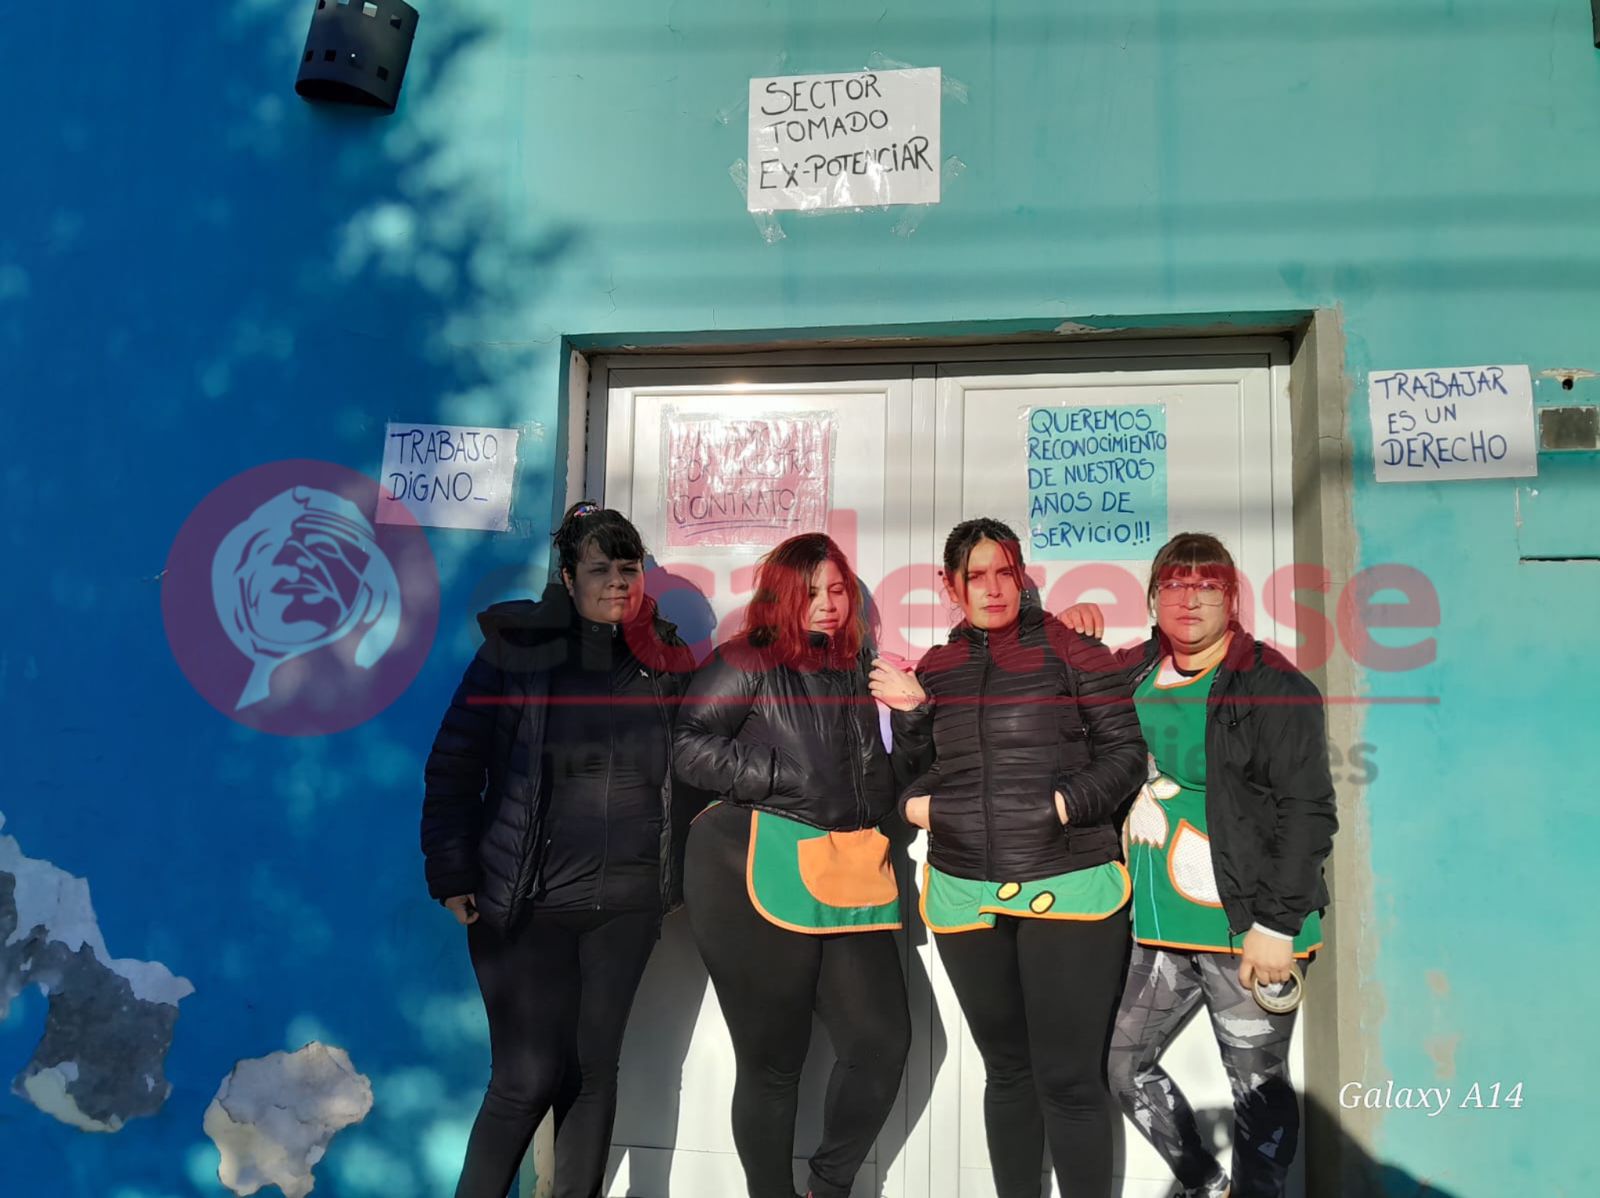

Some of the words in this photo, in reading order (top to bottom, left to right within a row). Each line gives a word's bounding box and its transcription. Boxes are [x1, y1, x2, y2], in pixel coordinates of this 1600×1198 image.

[761, 74, 882, 115] SECTOR
[767, 109, 888, 144] TOMADO
[1375, 367, 1508, 401] TRABAJAR
[1031, 408, 1151, 437] QUEREMOS
[1388, 410, 1416, 434] ES
[1425, 403, 1457, 424] UN
[391, 429, 498, 464] TRABAJO
[1381, 430, 1507, 469] DERECHO
[1028, 468, 1057, 489] DE
[1065, 458, 1155, 485] NUESTROS
[673, 488, 796, 524] CONTRATO
[1031, 491, 1092, 519] AÑOS
[1101, 491, 1135, 513] DE
